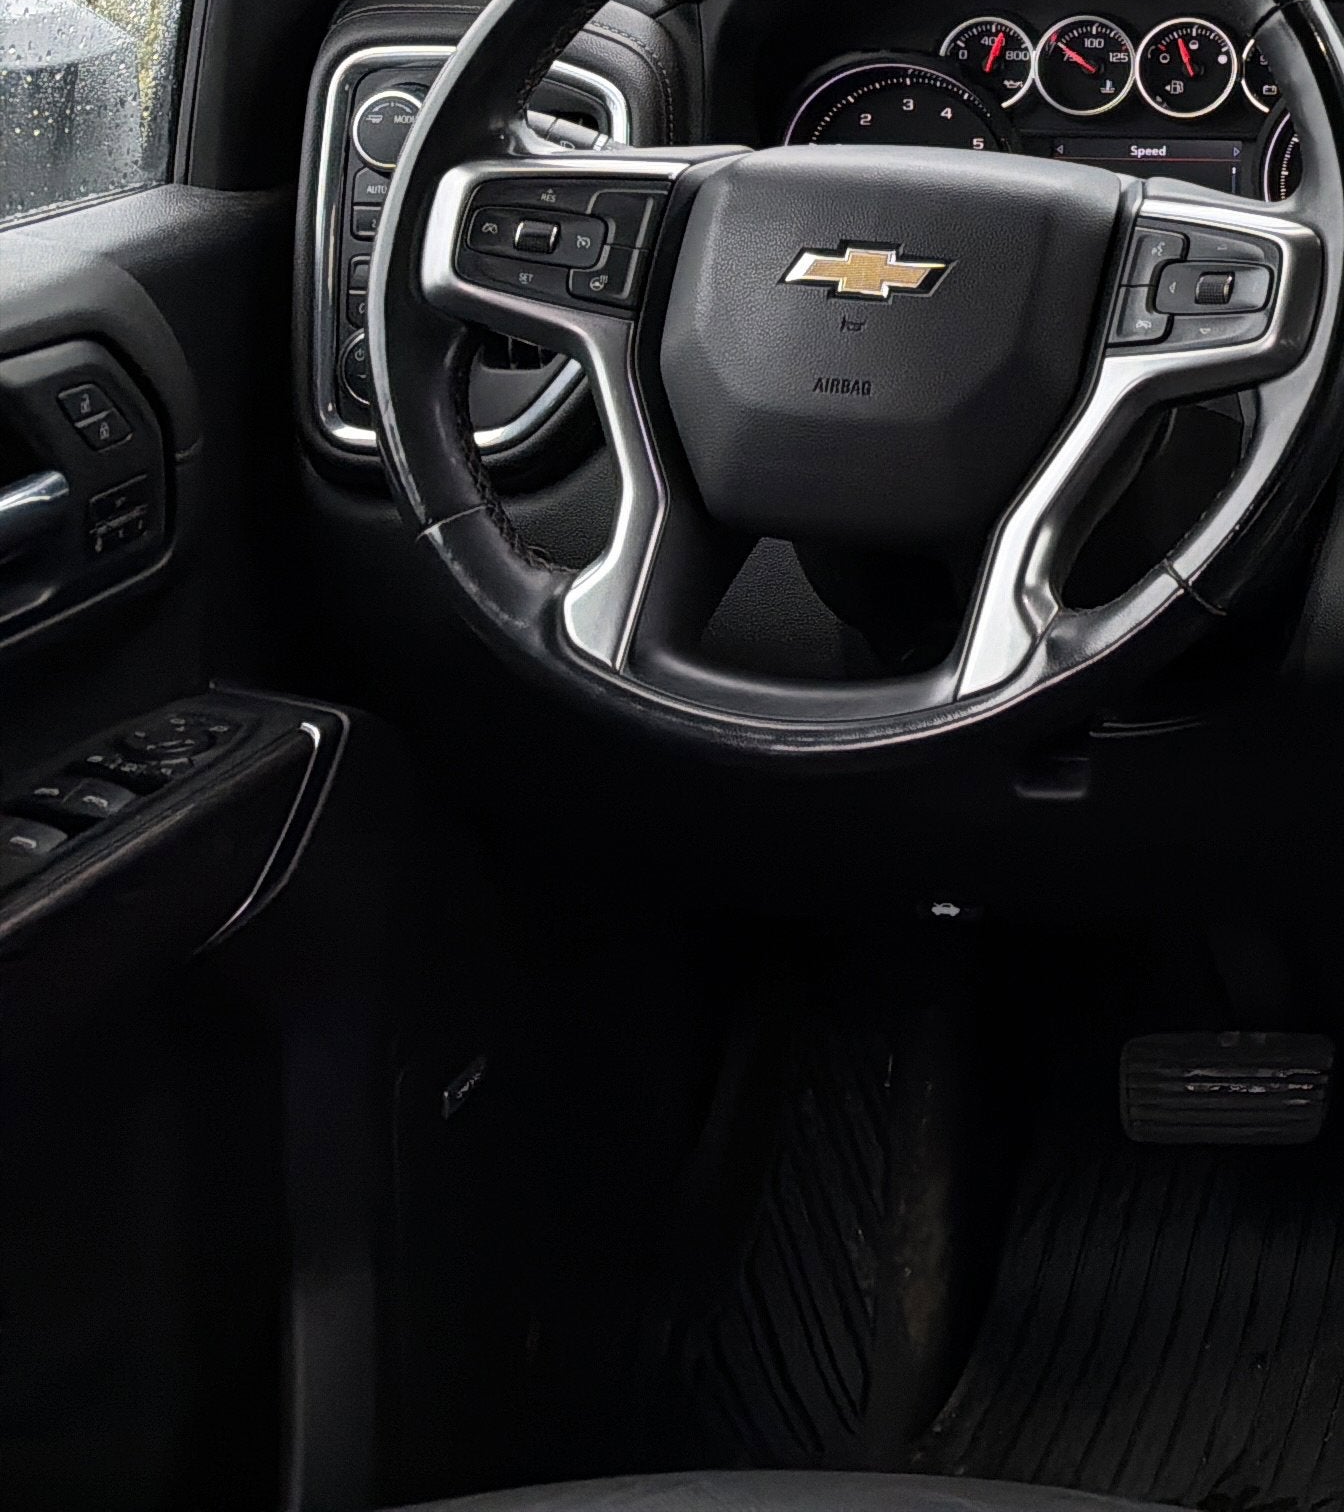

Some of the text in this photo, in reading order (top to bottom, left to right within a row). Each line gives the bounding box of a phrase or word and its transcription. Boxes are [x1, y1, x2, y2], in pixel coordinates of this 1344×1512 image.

[1084, 38, 1104, 48] 100
[958, 49, 968, 60] 0
[1005, 50, 1031, 61] 800
[1109, 52, 1129, 63] 125
[902, 98, 914, 111] 3
[859, 113, 872, 126] 2
[940, 107, 953, 120] 4
[972, 138, 985, 150] 5
[1130, 145, 1167, 158] Speed
[366, 185, 388, 195] AUTO
[540, 193, 557, 203] RES
[517, 271, 534, 283] SET
[812, 377, 872, 396] AIRBAG
